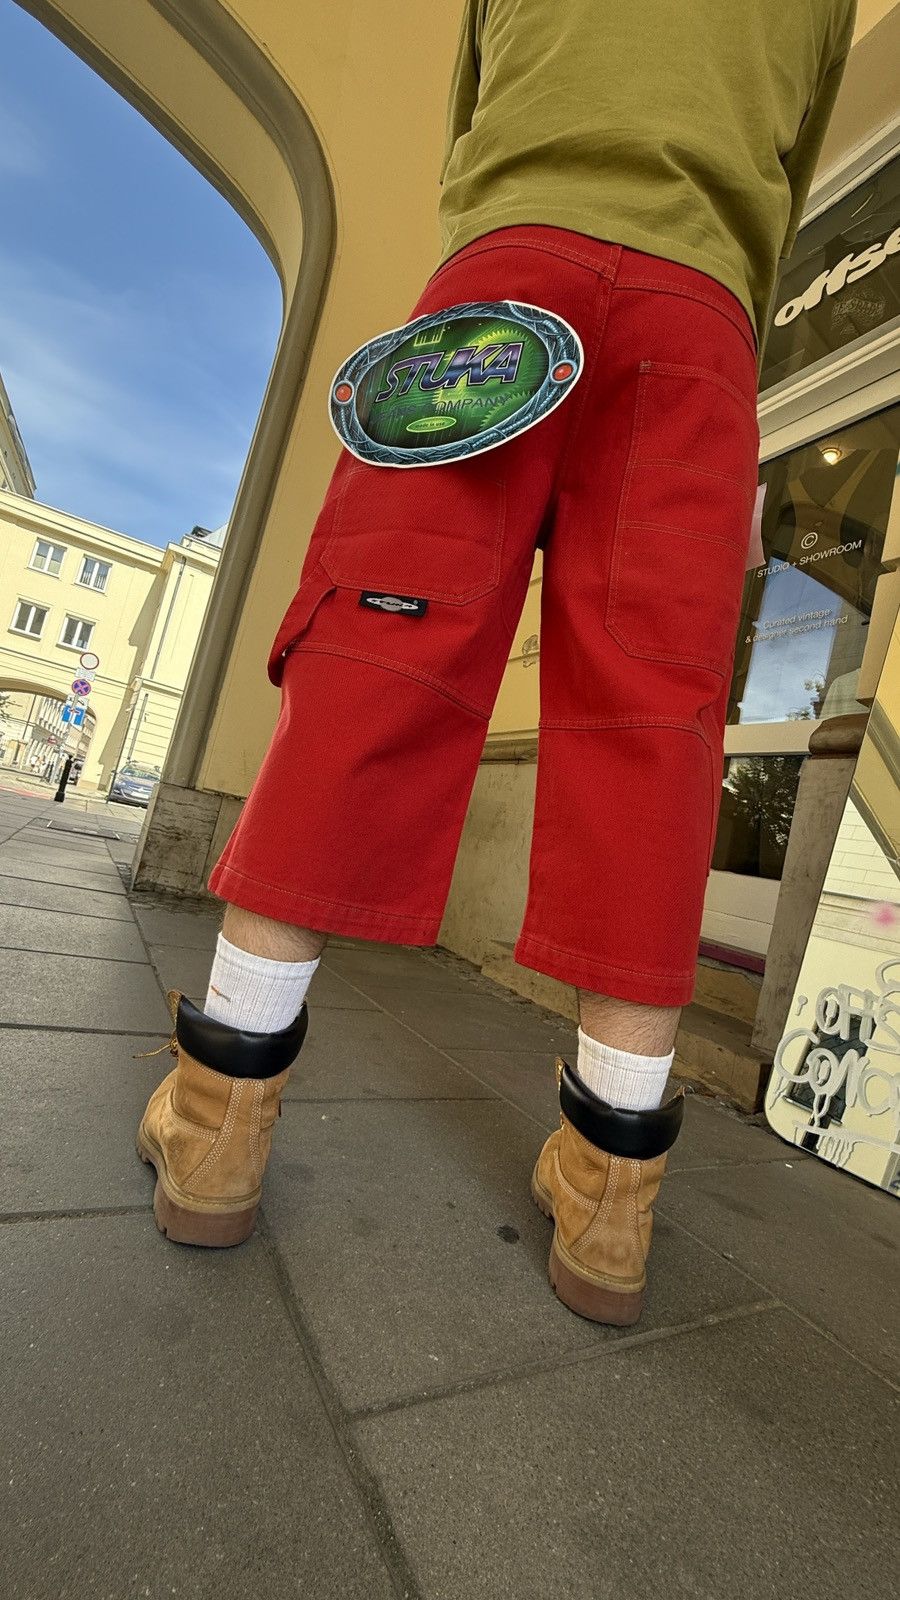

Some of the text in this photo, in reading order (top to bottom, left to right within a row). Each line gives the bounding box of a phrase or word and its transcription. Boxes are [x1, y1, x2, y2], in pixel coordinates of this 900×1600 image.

[375, 342, 525, 402] STUKA
[757, 561, 791, 578] STUDIO
[799, 539, 863, 566] SHOWROOM
[744, 614, 849, 644] & designer second hand
[763, 608, 832, 629] Curated vintage
